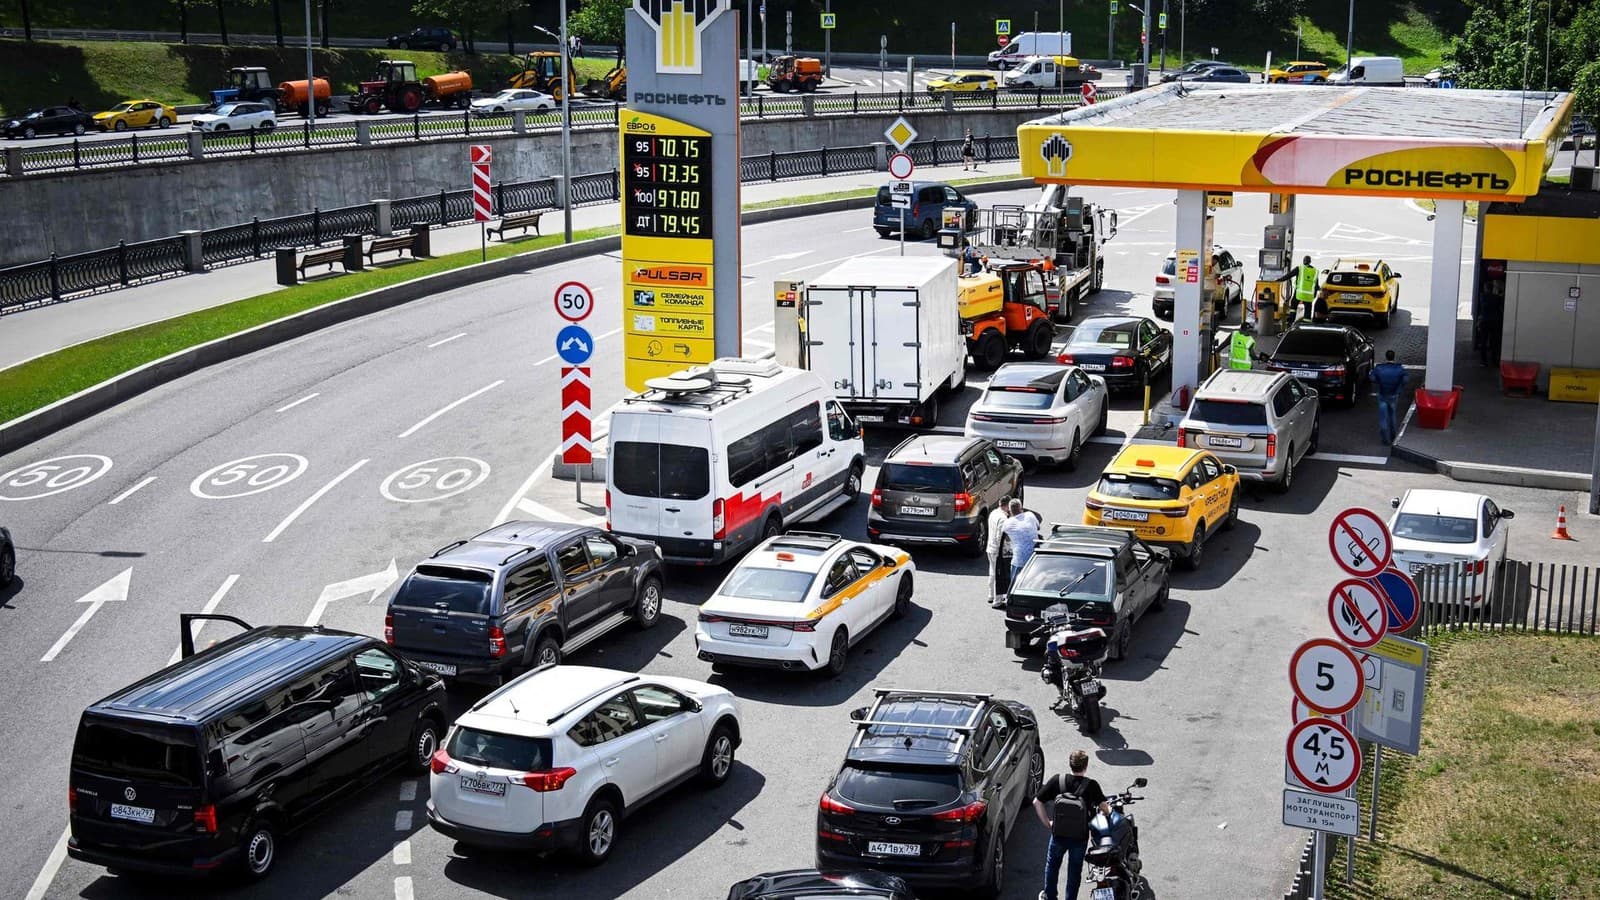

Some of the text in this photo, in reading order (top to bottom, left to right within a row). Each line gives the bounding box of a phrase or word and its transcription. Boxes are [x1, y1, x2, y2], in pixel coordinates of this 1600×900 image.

[634, 93, 726, 105] РОСНЕФТЬ
[626, 122, 650, 130] ЕВРО
[635, 138, 699, 158] 95 70.75
[636, 164, 699, 183] 95 73.35
[1344, 168, 1510, 190] РОСНЕФТЬ
[635, 189, 700, 209] 100 97.80
[636, 214, 700, 234] ДТ 79.45
[563, 293, 584, 309] 50
[660, 292, 704, 300] СЕМЕЙНАЯ
[660, 317, 704, 325] ТОПЛИВНЫЕ
[9, 465, 92, 487] 50
[211, 464, 289, 486] 50
[398, 467, 472, 490] 50
[1315, 662, 1335, 692] 5
[1303, 733, 1345, 761] 4,5
[1286, 804, 1356, 821] МОТОТРАНСПОРТ
[1297, 797, 1345, 811] ЗАГЛУШИТЬ
[1306, 816, 1317, 824] ЗА
